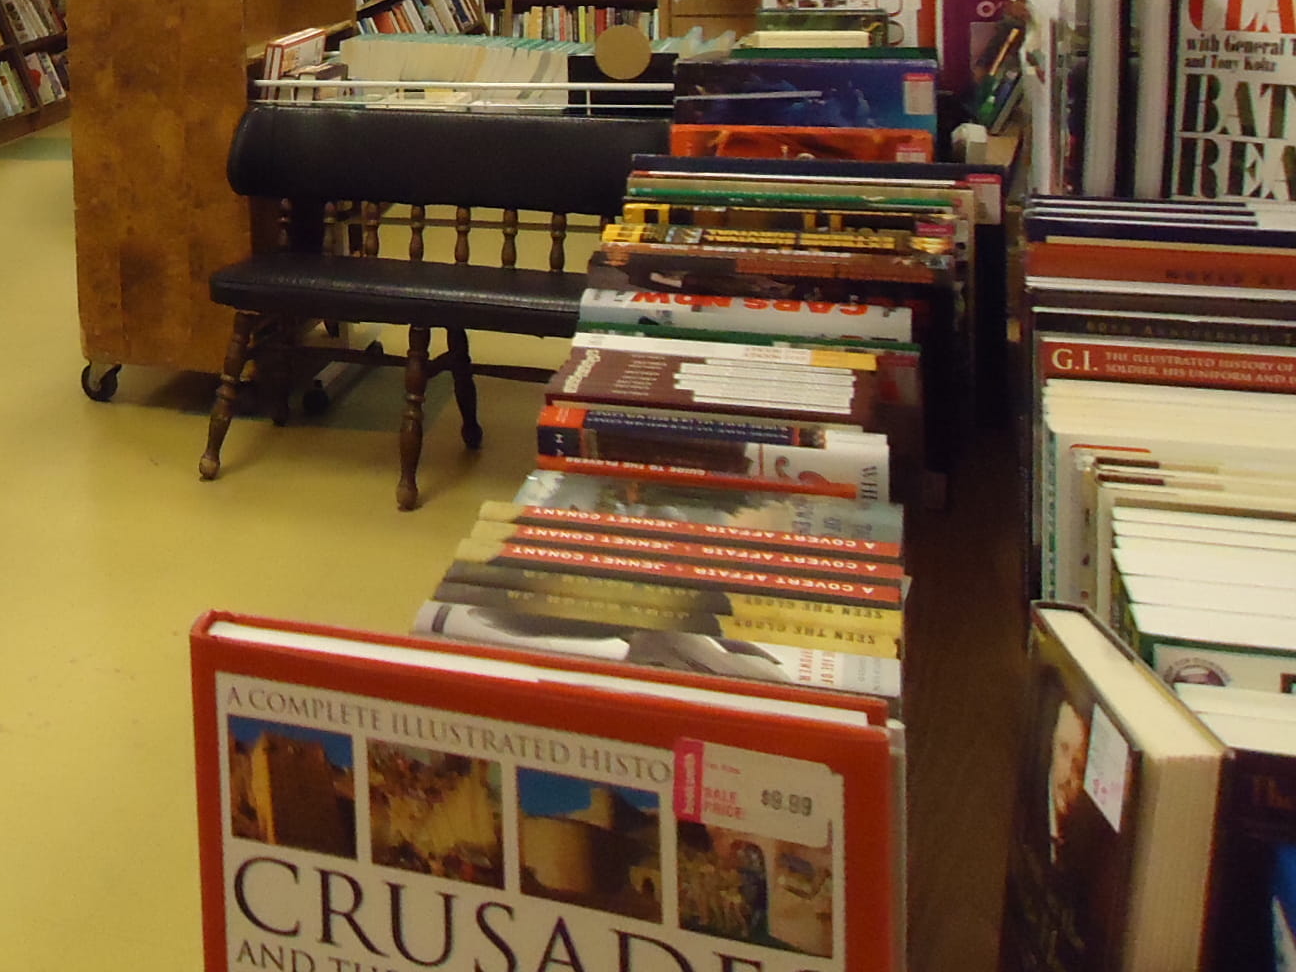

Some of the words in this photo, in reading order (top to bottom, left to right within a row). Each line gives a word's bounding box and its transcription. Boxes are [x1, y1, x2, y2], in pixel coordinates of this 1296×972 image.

[1185, 33, 1221, 54] with
[1223, 36, 1285, 57] General
[1183, 55, 1207, 70] and
[1209, 54, 1241, 72] Tony
[1051, 347, 1100, 372] G.I.
[1105, 351, 1130, 363] THE
[1132, 353, 1215, 368] ILLUSTRATED
[1218, 358, 1274, 372] HISTORY
[1162, 366, 1186, 378] HIS
[1188, 368, 1252, 382] UNIFORM
[1254, 373, 1286, 385] AND
[670, 465, 706, 477] GUIDE
[531, 507, 601, 521] CONANT
[604, 514, 679, 529] JENNET
[523, 527, 595, 542] CONANT
[703, 524, 776, 539] AFFAIR
[599, 535, 675, 551] JENNET
[780, 533, 857, 548] COVERT
[863, 541, 877, 550] A
[511, 546, 584, 562] CONANT
[702, 546, 775, 561] AFFAIR
[589, 554, 667, 570] JENNET
[779, 554, 858, 570] COVERT
[865, 563, 877, 572] A
[693, 567, 768, 582] AFFAIR
[774, 576, 855, 592] COVERT
[861, 586, 875, 595] A
[793, 625, 825, 639] THE
[834, 630, 876, 645] SEEN
[226, 685, 243, 708] A
[248, 689, 382, 731] COMPLETE
[391, 713, 571, 765] ILLUSTRATED
[233, 855, 825, 972] CRUSAD
[236, 939, 315, 972] AND
[328, 956, 402, 972] TH
